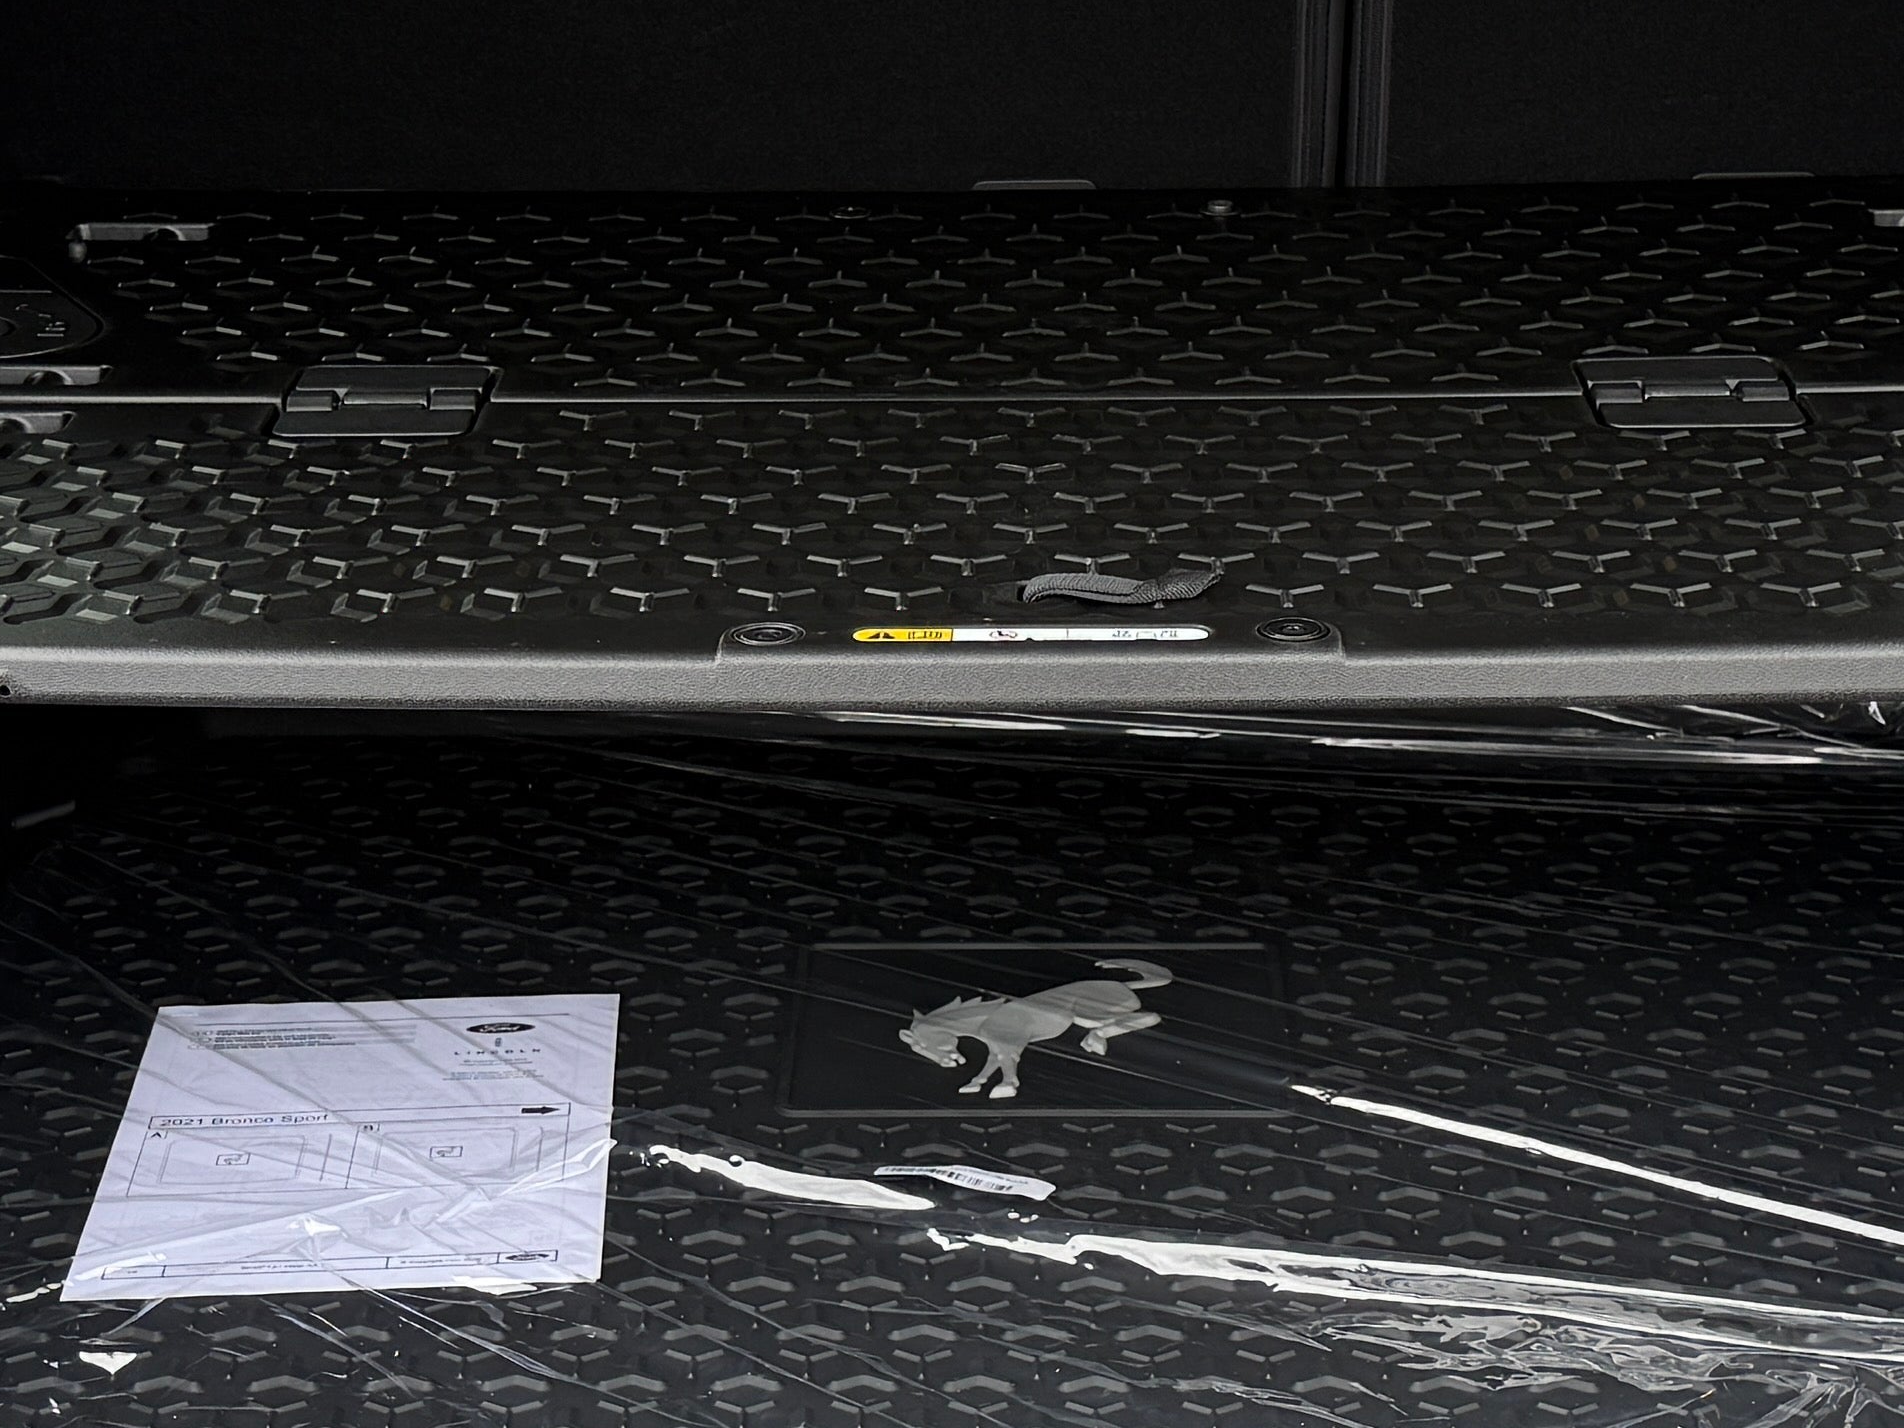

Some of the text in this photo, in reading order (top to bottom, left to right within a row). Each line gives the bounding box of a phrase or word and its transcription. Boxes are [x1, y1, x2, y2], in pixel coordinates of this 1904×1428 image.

[454, 1048, 541, 1056] LINCOLN
[160, 1114, 329, 1127] 2021 Bronco Sport
